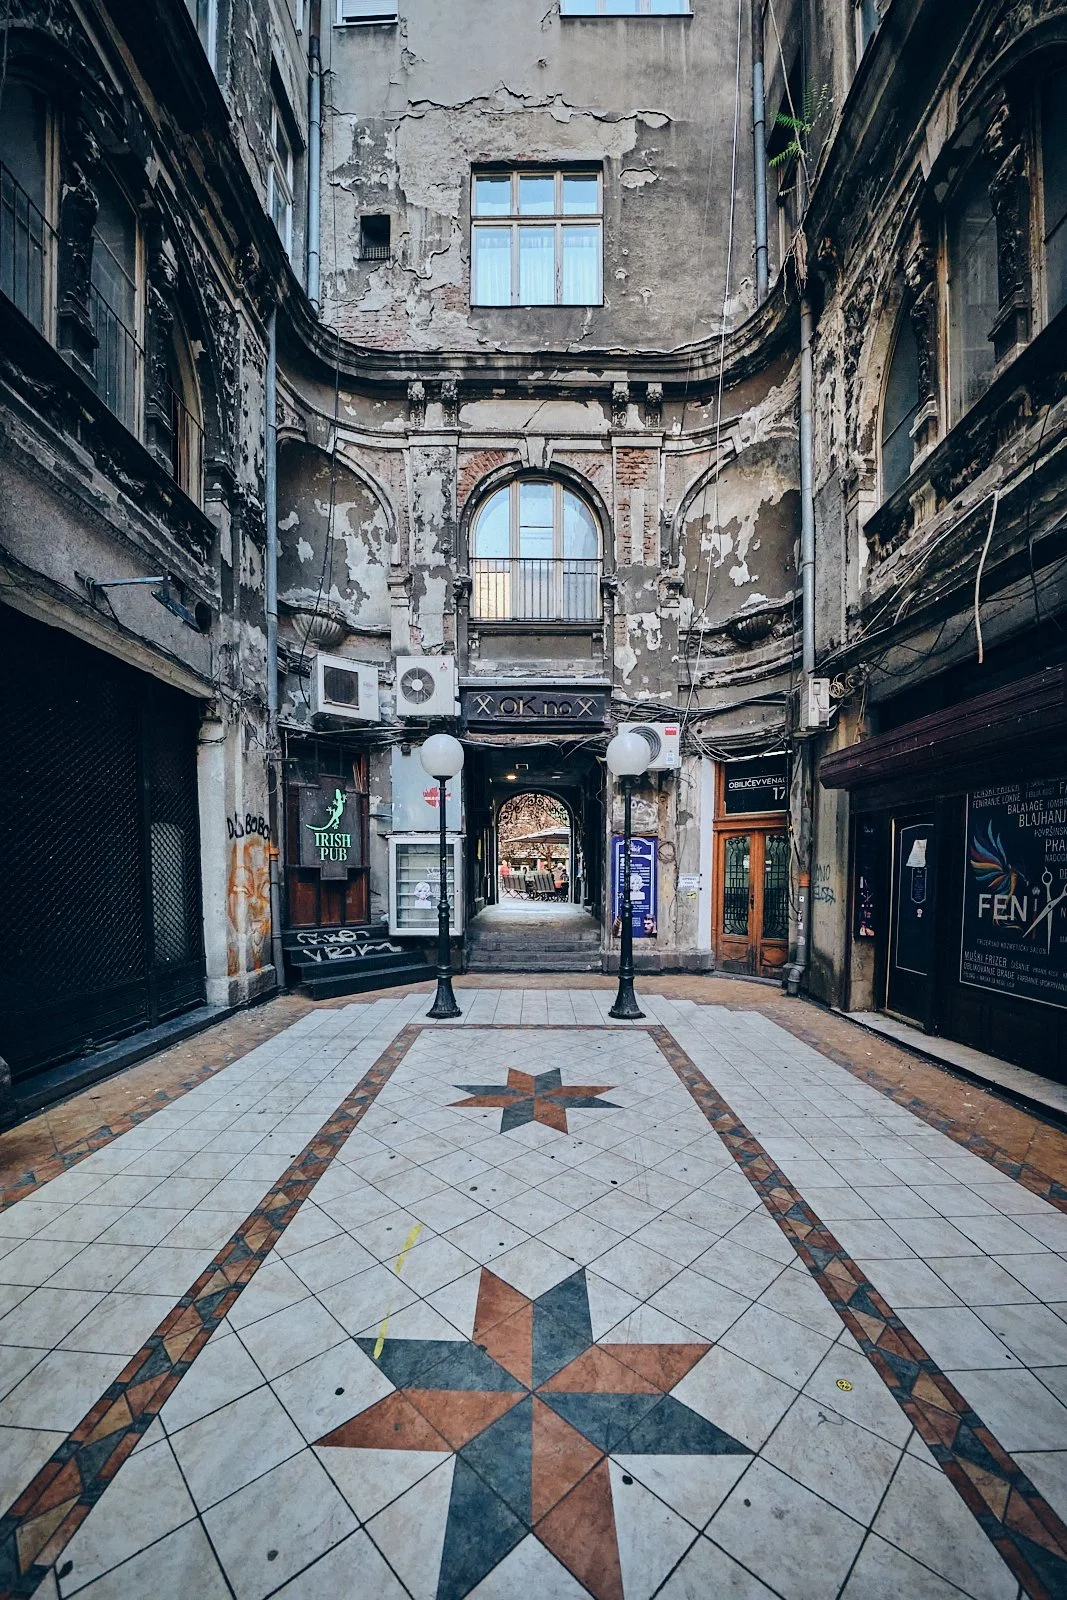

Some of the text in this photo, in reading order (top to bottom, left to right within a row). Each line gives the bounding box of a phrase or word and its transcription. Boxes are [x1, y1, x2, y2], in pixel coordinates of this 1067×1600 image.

[773, 786, 786, 800] 17
[314, 832, 352, 848] IRISH
[319, 847, 348, 861] PUB
[984, 954, 1007, 967] FRIZER
